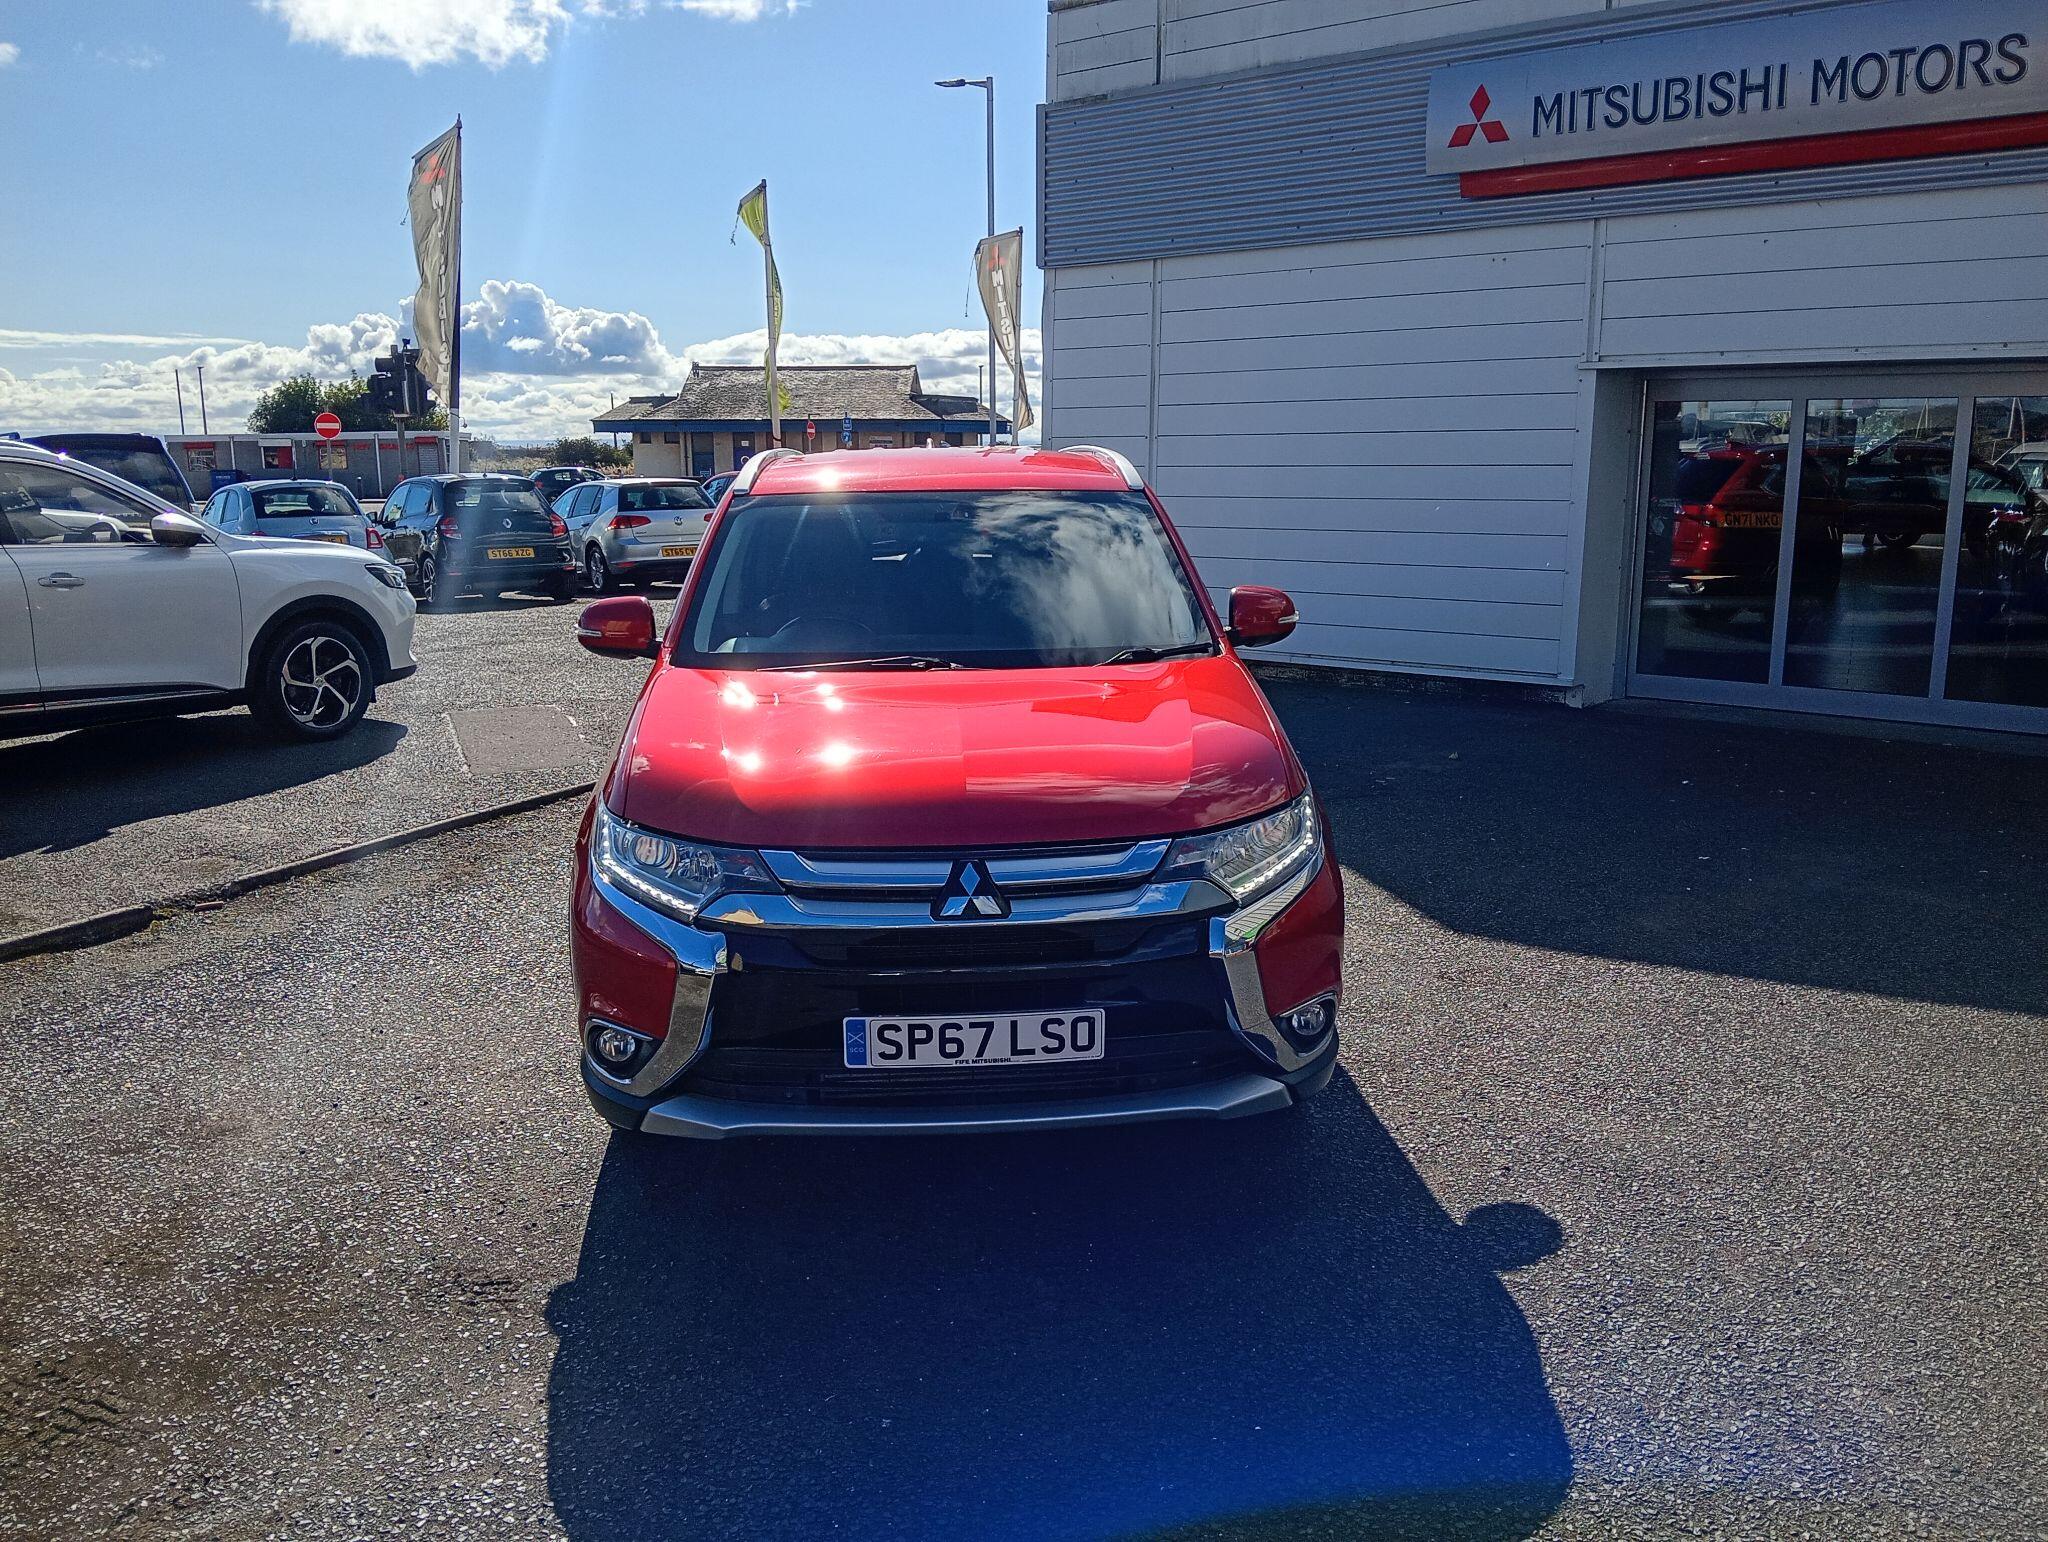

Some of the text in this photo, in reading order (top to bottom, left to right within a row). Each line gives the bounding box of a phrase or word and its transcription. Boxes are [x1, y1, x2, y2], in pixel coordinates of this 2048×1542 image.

[1531, 32, 2030, 138] MITSUBISHI MOTORS
[491, 548, 531, 558] ST66 XZG
[684, 546, 697, 556] CV
[876, 1015, 1096, 1061] SP67 LSO
